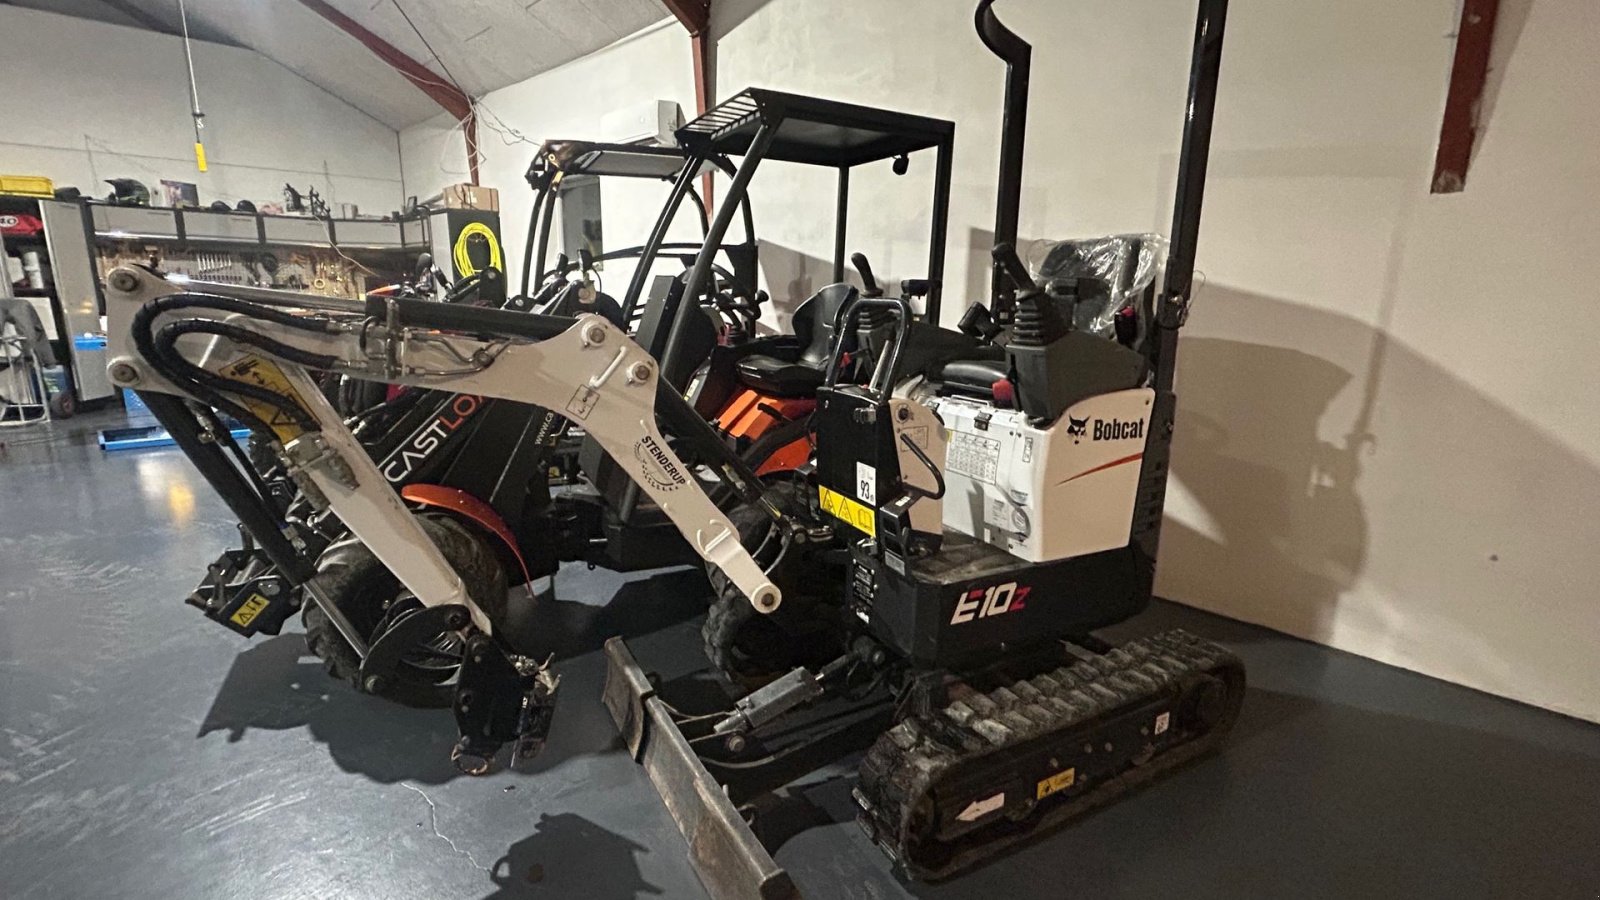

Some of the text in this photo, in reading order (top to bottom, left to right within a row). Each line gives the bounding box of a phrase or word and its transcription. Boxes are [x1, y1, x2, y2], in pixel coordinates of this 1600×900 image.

[384, 396, 482, 482] CASTLO
[1093, 418, 1144, 441] Bobcat
[641, 435, 686, 485] STENDERUP
[861, 480, 870, 500] 93
